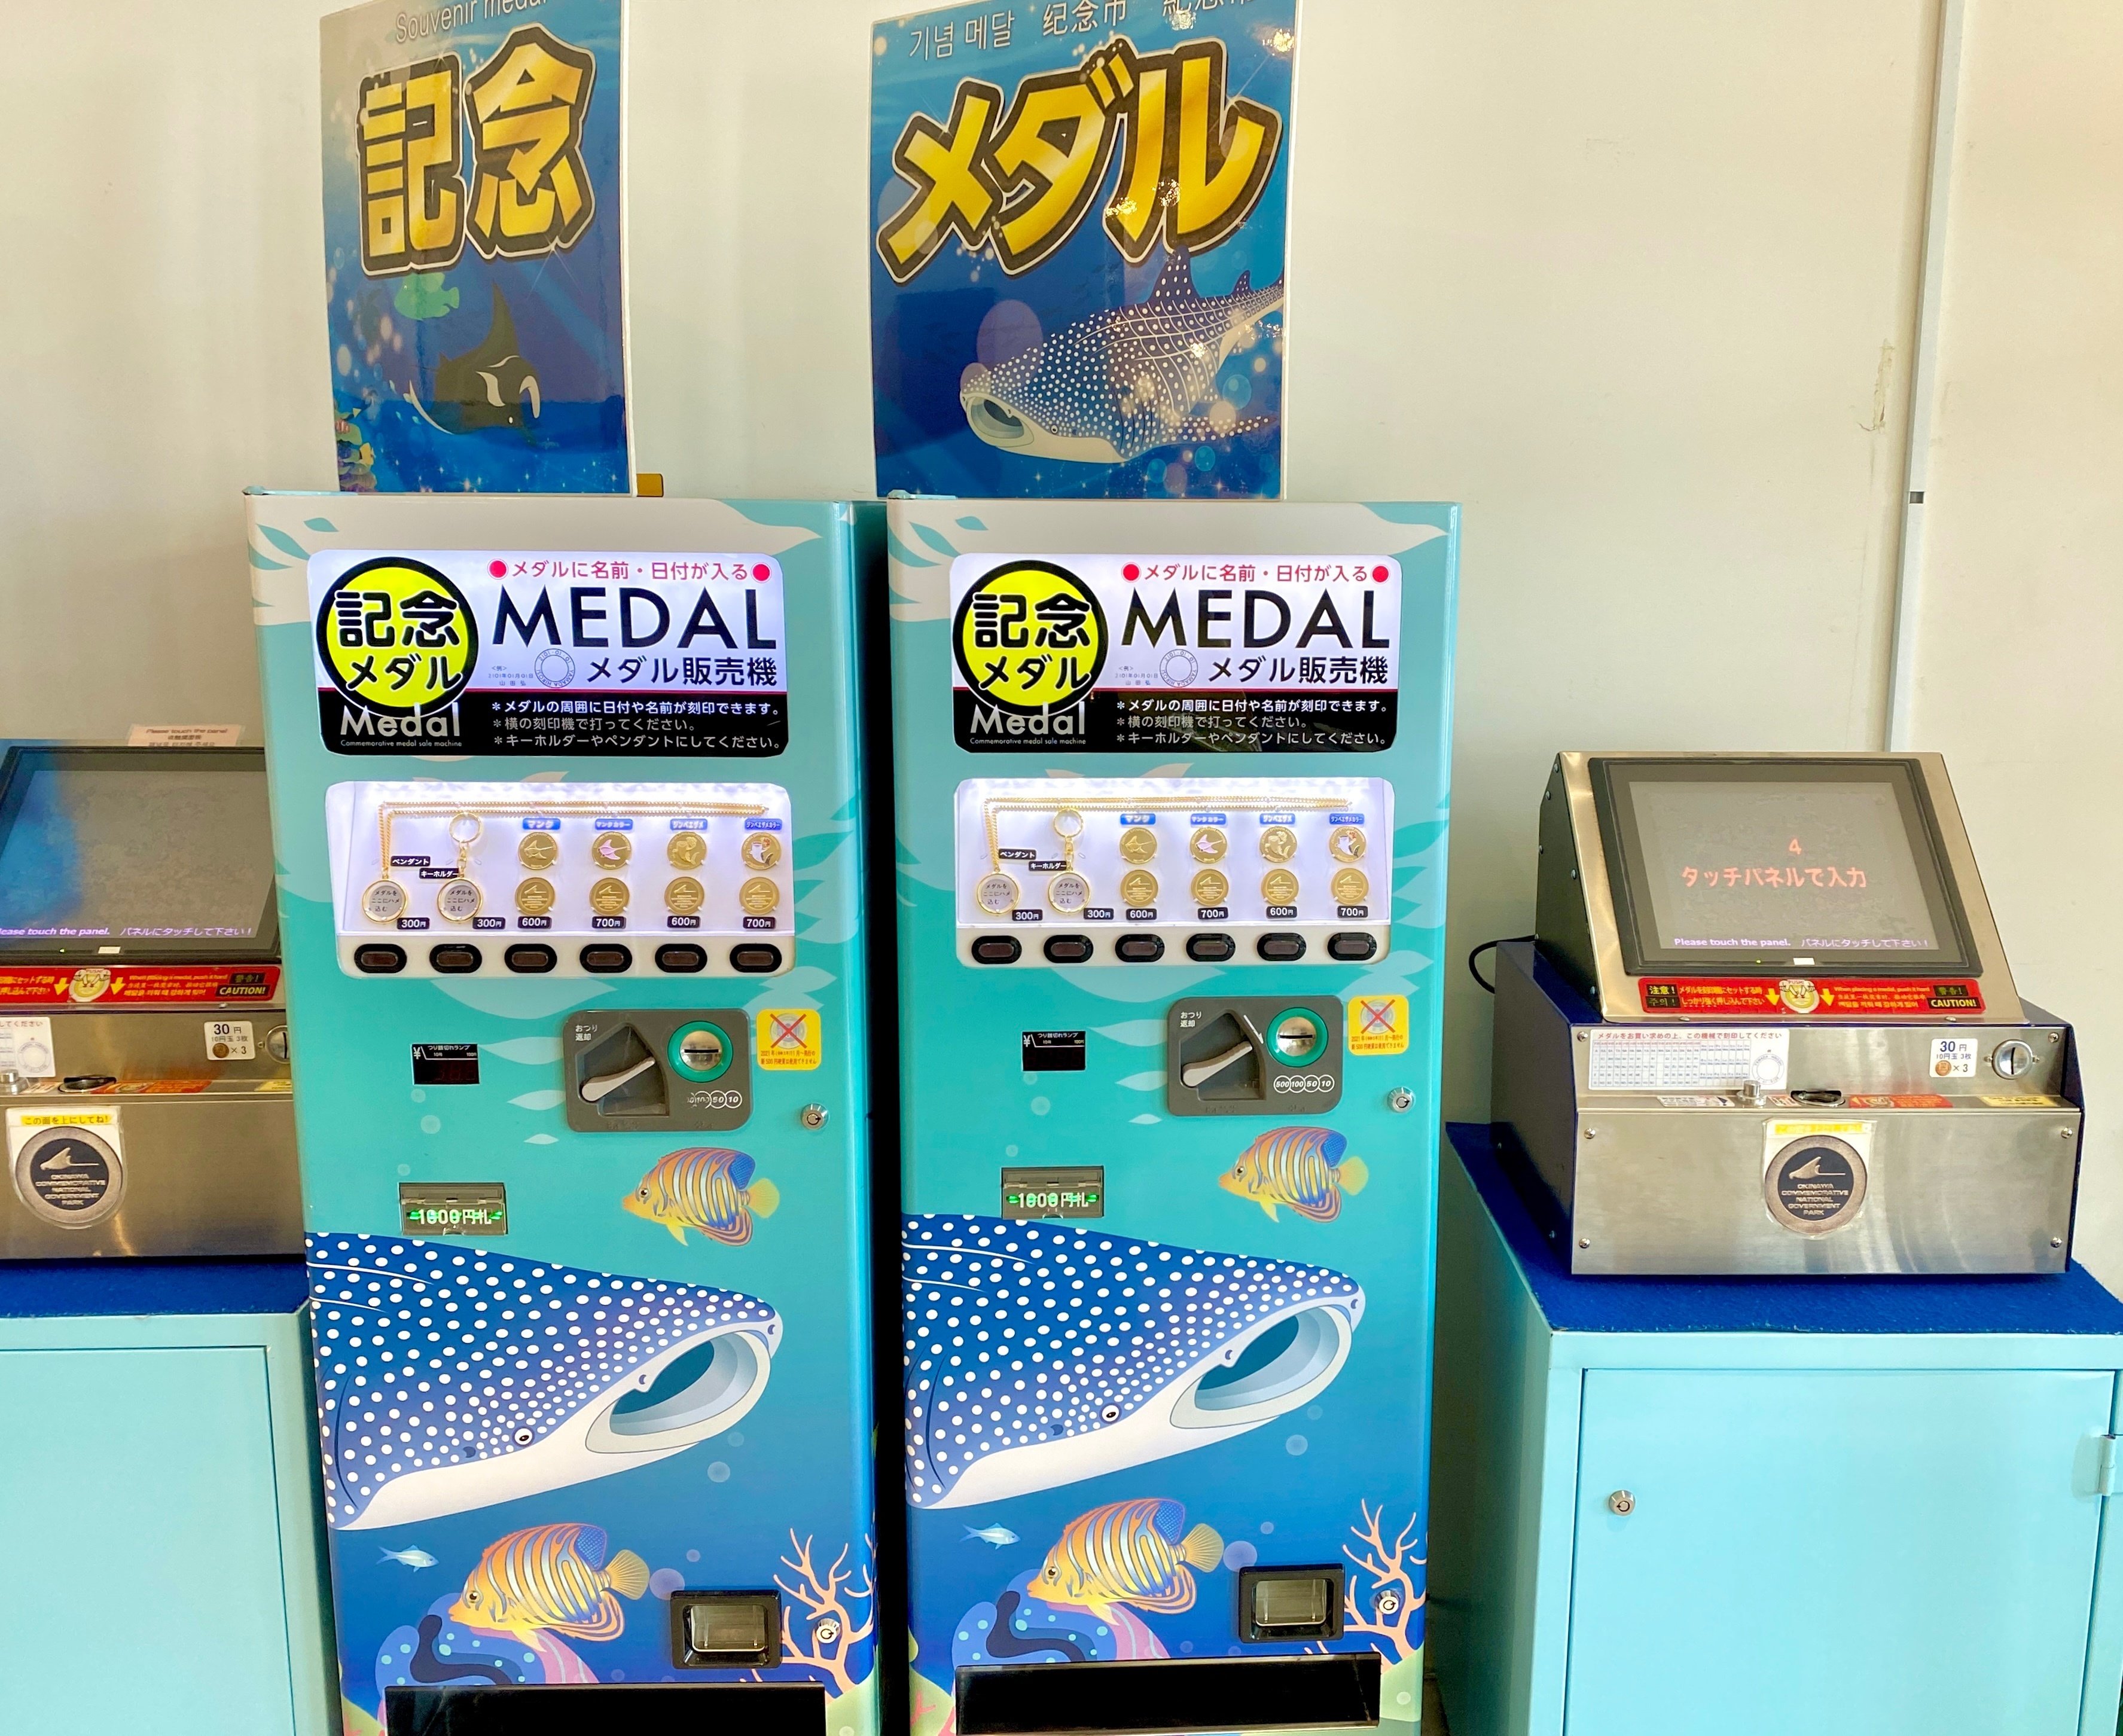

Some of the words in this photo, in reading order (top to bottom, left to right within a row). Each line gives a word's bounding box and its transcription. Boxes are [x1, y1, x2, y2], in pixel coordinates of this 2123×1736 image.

[396, 0, 477, 42] Souvenir
[909, 22, 954, 60] 기념
[965, 10, 1015, 49] 메달
[361, 33, 591, 269] 記念
[880, 42, 1277, 275] メダル
[511, 560, 749, 581] メダルに名前・日付が入る
[1143, 563, 1368, 582] メダルに名前・日付が入る
[333, 589, 460, 649] 記念
[490, 584, 777, 649] MEDAL
[972, 592, 1093, 649] 記念
[1121, 588, 1390, 649] MEDAL
[346, 652, 463, 693] メダル
[585, 657, 778, 687] メダル販売機
[978, 654, 1093, 692] メダル
[1207, 655, 1389, 685] メダル販売機
[341, 702, 460, 737] Medal
[970, 701, 1086, 735] Medal
[1789, 838, 1802, 855] 4
[1000, 850, 1035, 859] ペンダント
[1680, 866, 1867, 888] タッチパネルで入力
[1015, 912, 1039, 920] 300円
[1087, 910, 1111, 918] 300円
[1130, 910, 1154, 918] 600円
[1201, 908, 1225, 917] 700円
[1270, 907, 1294, 916] 600円
[1340, 908, 1364, 916] 700円
[401, 919, 426, 928] 300円
[477, 919, 502, 928] 300円
[521, 918, 547, 926] 600円
[596, 919, 620, 927] 700円
[671, 917, 696, 926] 600円
[746, 919, 771, 928] 700円
[78, 928, 110, 936] panel.
[1674, 938, 1708, 947] Please
[1710, 938, 1738, 947] touch
[1741, 938, 1758, 947] the
[1761, 938, 1791, 948] panel.
[219, 987, 266, 995] CAUTION!
[213, 1024, 230, 1035] 30
[575, 1024, 597, 1033] おつり
[575, 1033, 591, 1041] 返却
[1939, 1041, 1956, 1052] 30
[1963, 1064, 1968, 1072] 3
